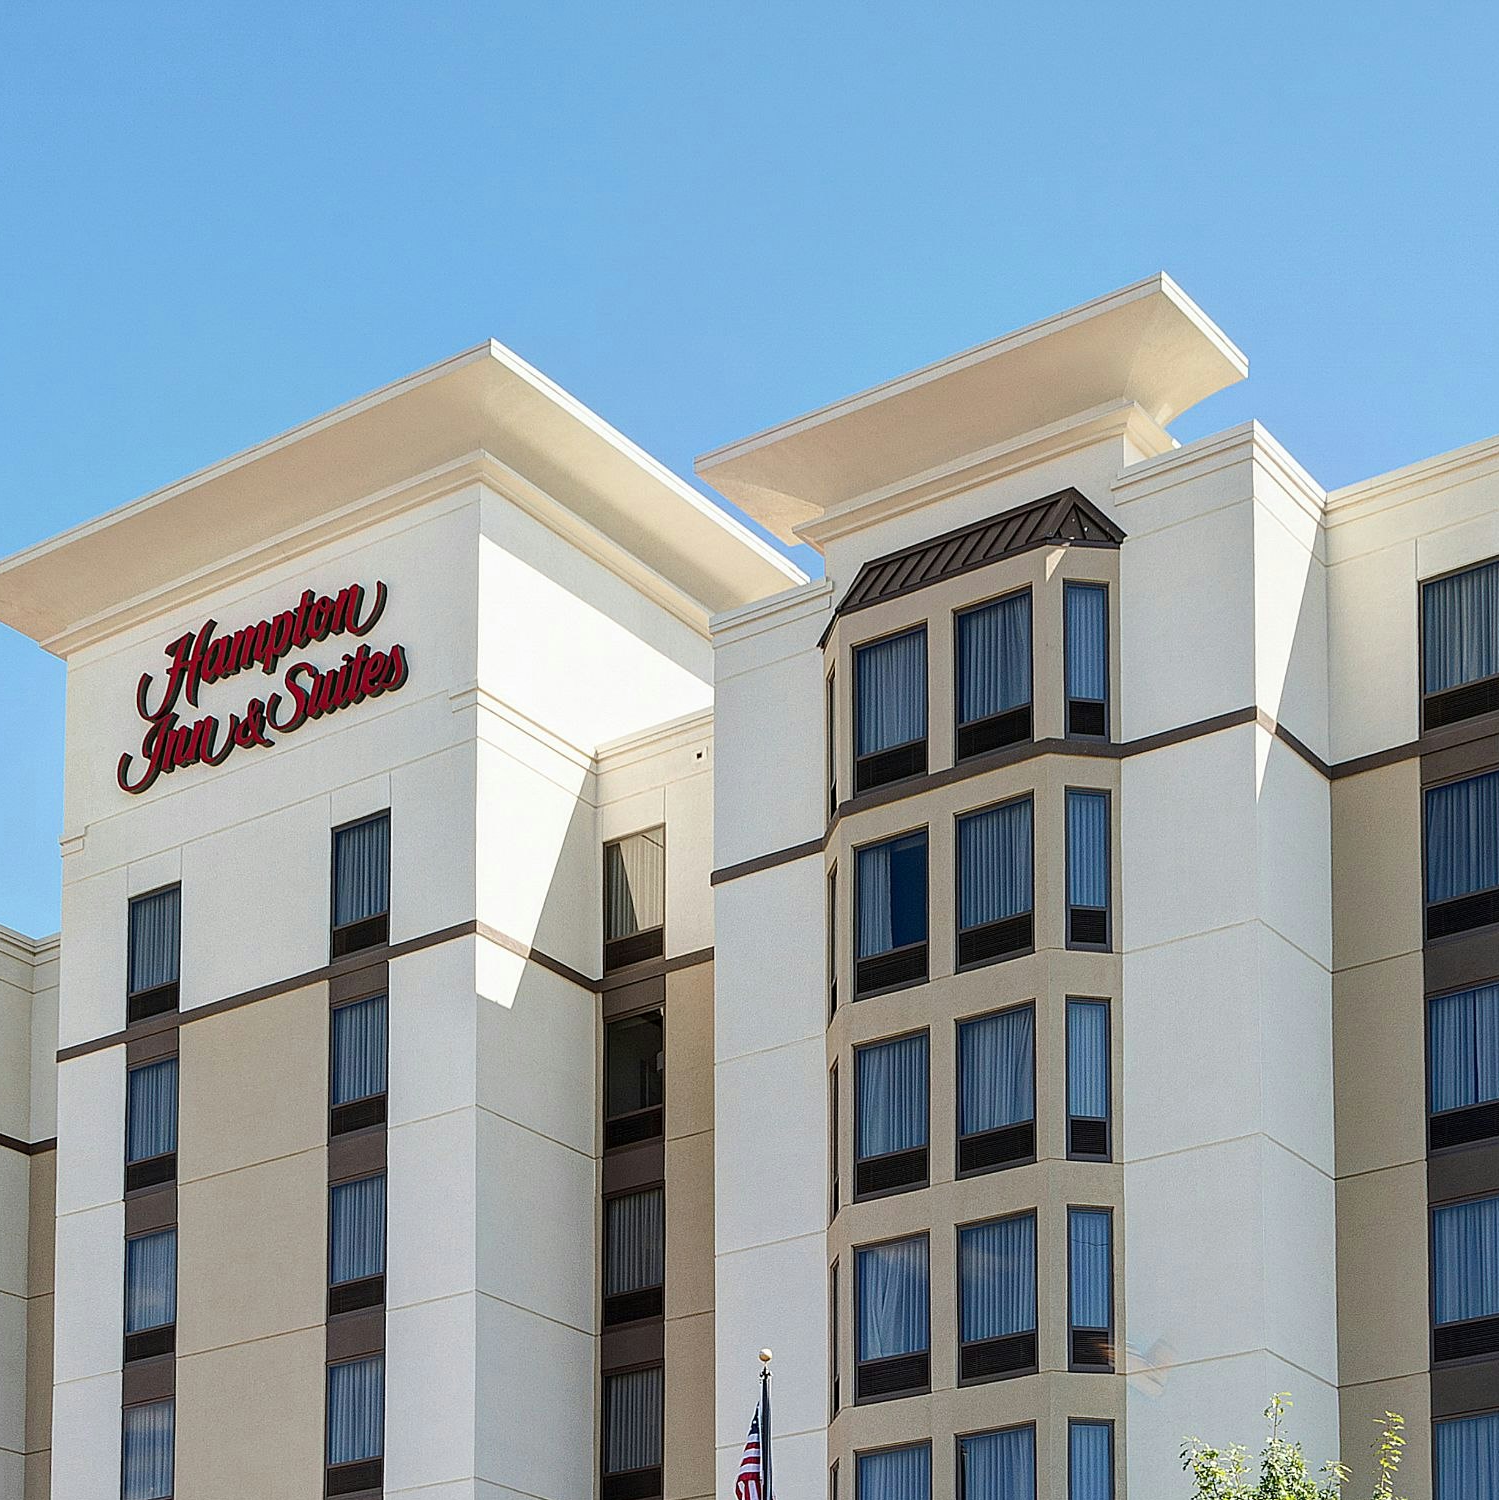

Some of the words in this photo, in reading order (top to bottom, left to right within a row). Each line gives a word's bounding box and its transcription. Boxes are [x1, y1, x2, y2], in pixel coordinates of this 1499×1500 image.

[116, 711, 239, 795] Inn
[235, 697, 275, 749] &
[266, 643, 409, 733] Suites
[136, 579, 388, 723] Hampton
